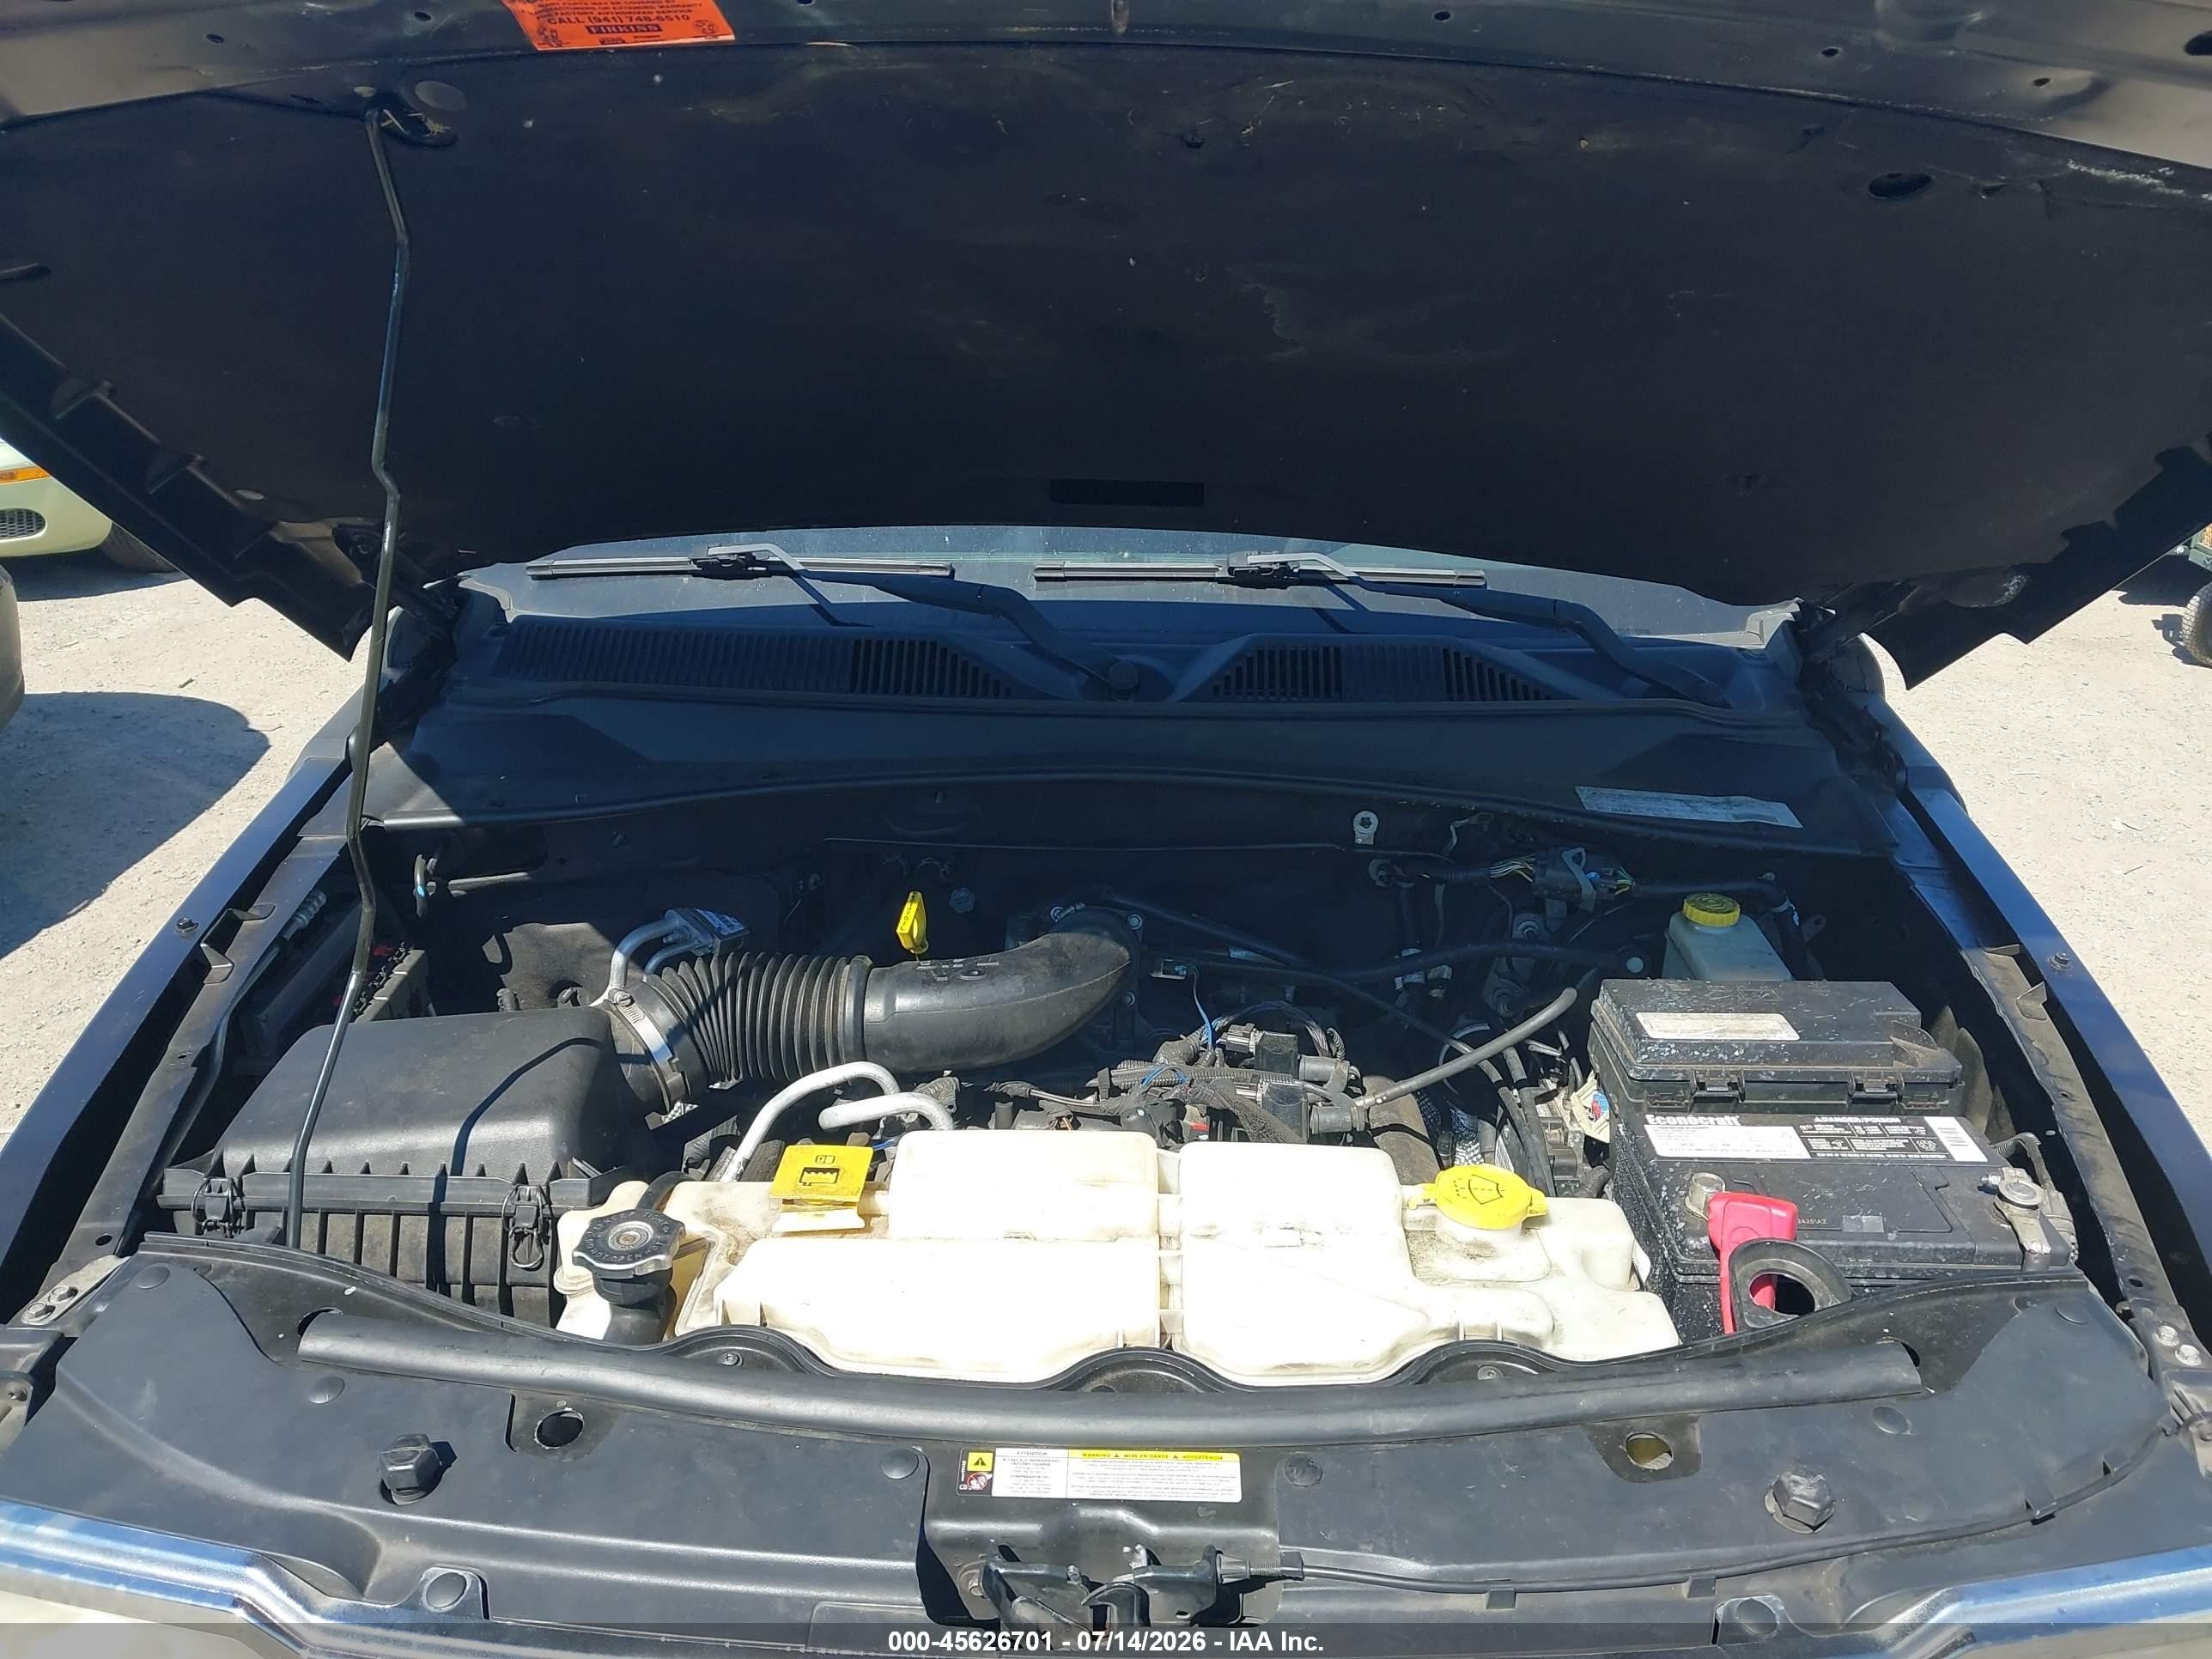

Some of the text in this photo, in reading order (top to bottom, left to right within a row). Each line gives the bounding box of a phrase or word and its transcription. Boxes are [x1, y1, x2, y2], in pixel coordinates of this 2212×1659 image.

[548, 16, 585, 25] CALL
[587, 15, 623, 24] (941)
[591, 25, 658, 33] FIRKINS
[1644, 1115, 1741, 1127] Econocraft
